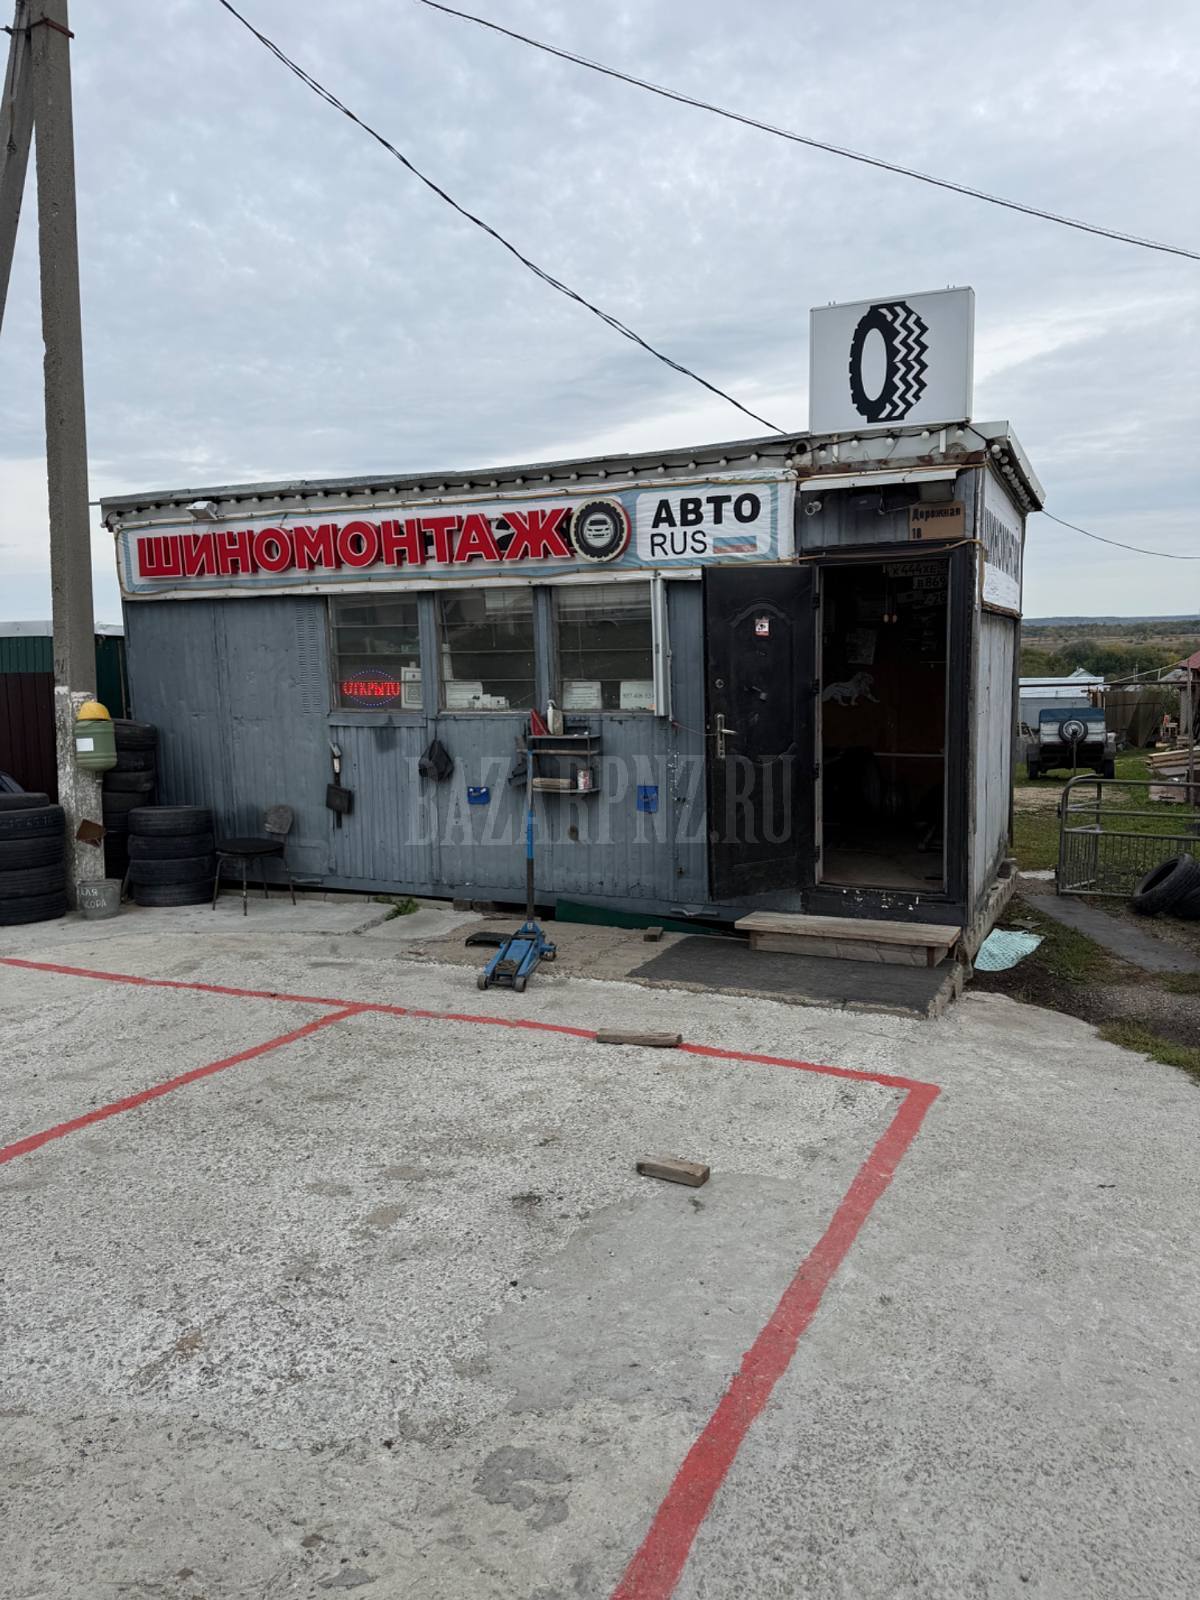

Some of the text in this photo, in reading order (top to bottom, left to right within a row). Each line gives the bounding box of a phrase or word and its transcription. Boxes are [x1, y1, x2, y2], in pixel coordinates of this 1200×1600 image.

[652, 493, 761, 529] АВТО
[137, 508, 573, 577] ШИНОМОНТАЖ
[650, 531, 707, 556] RUS
[343, 681, 400, 696] ОТКРЫТО
